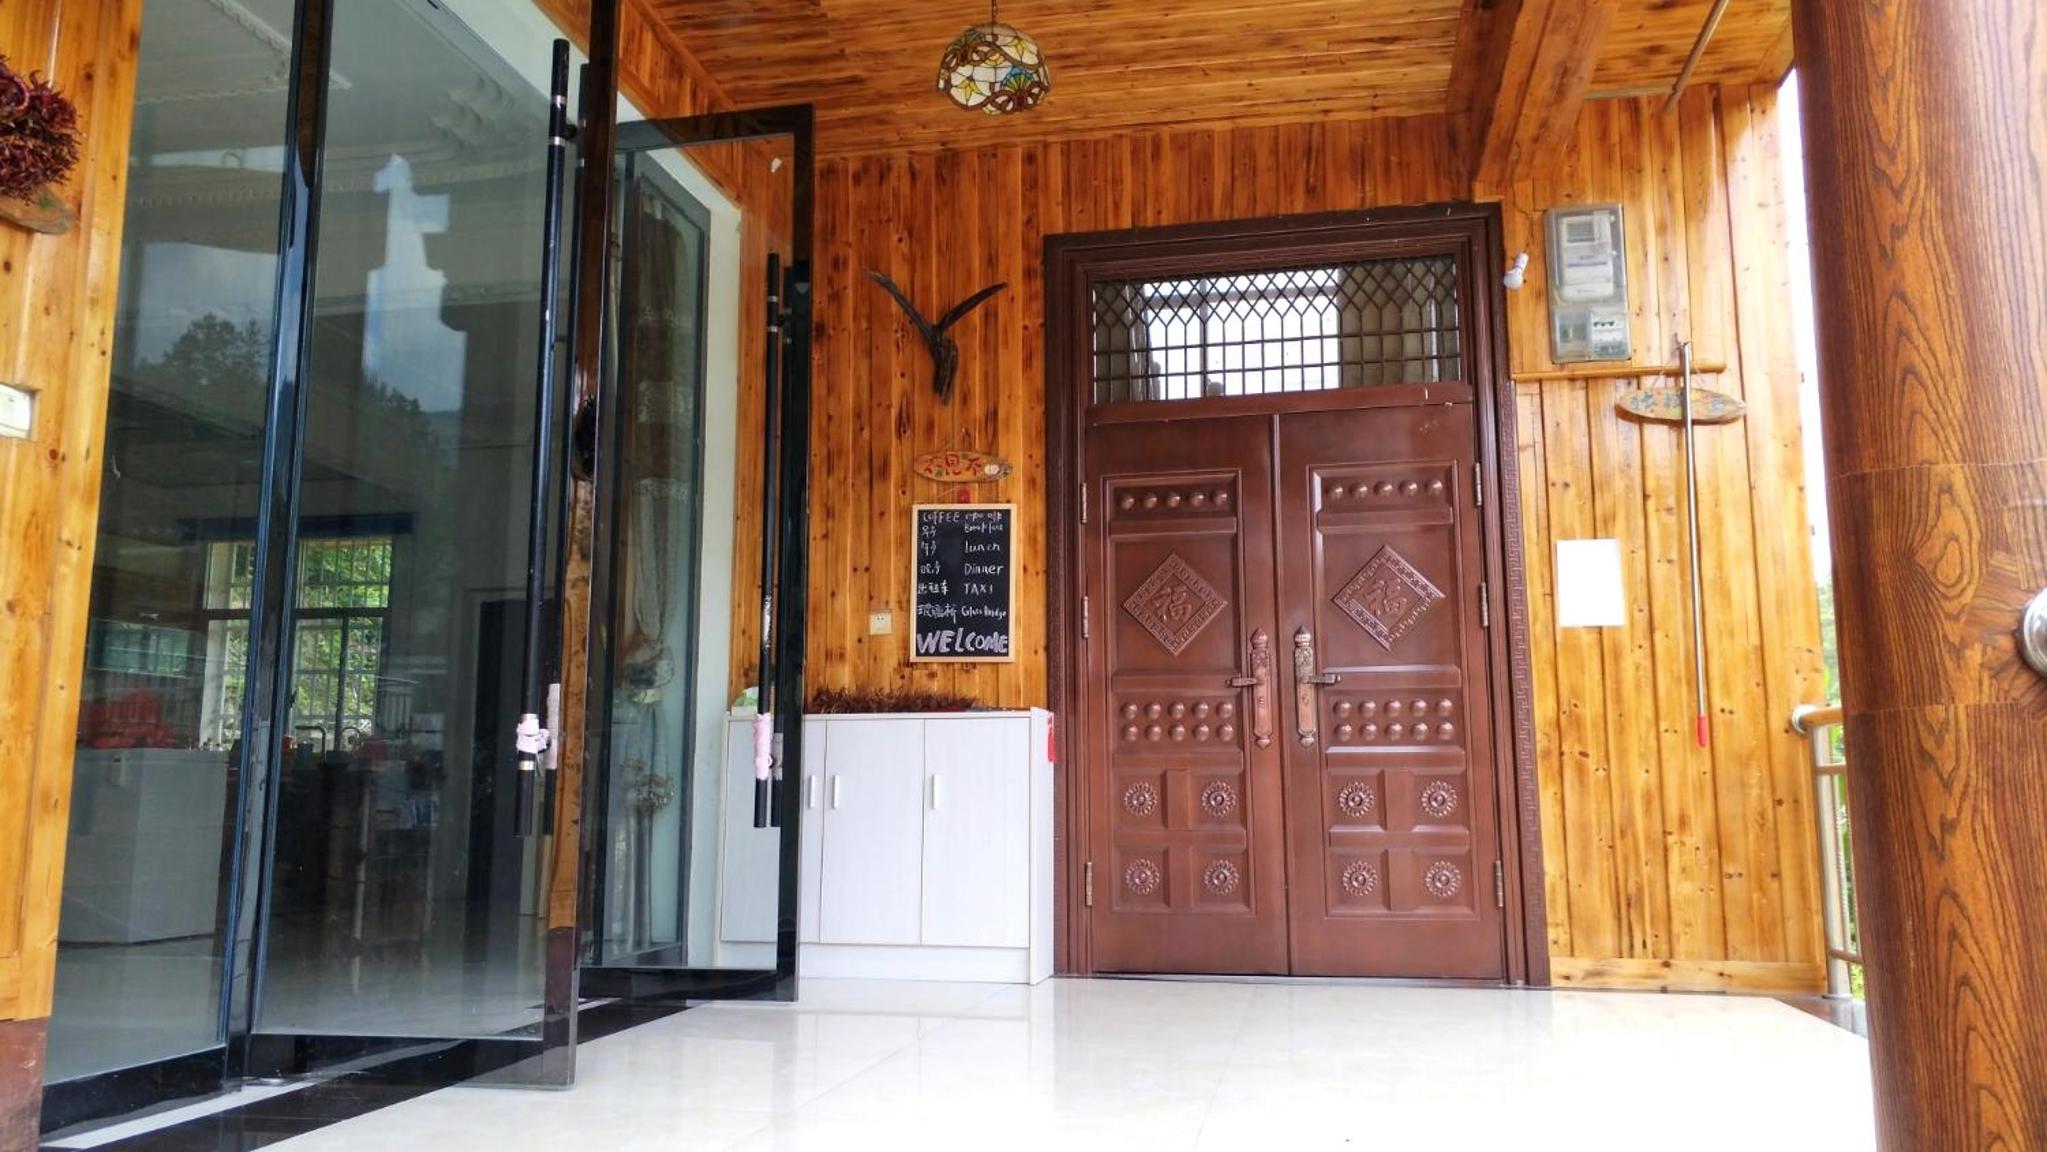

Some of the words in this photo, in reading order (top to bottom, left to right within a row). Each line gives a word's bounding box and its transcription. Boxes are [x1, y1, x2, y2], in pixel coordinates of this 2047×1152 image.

[923, 511, 960, 525] COFFEE
[964, 563, 1005, 576] Dinner
[917, 579, 949, 596] 出租车
[964, 583, 994, 596] TAXI
[916, 627, 1009, 654] WELCOME
